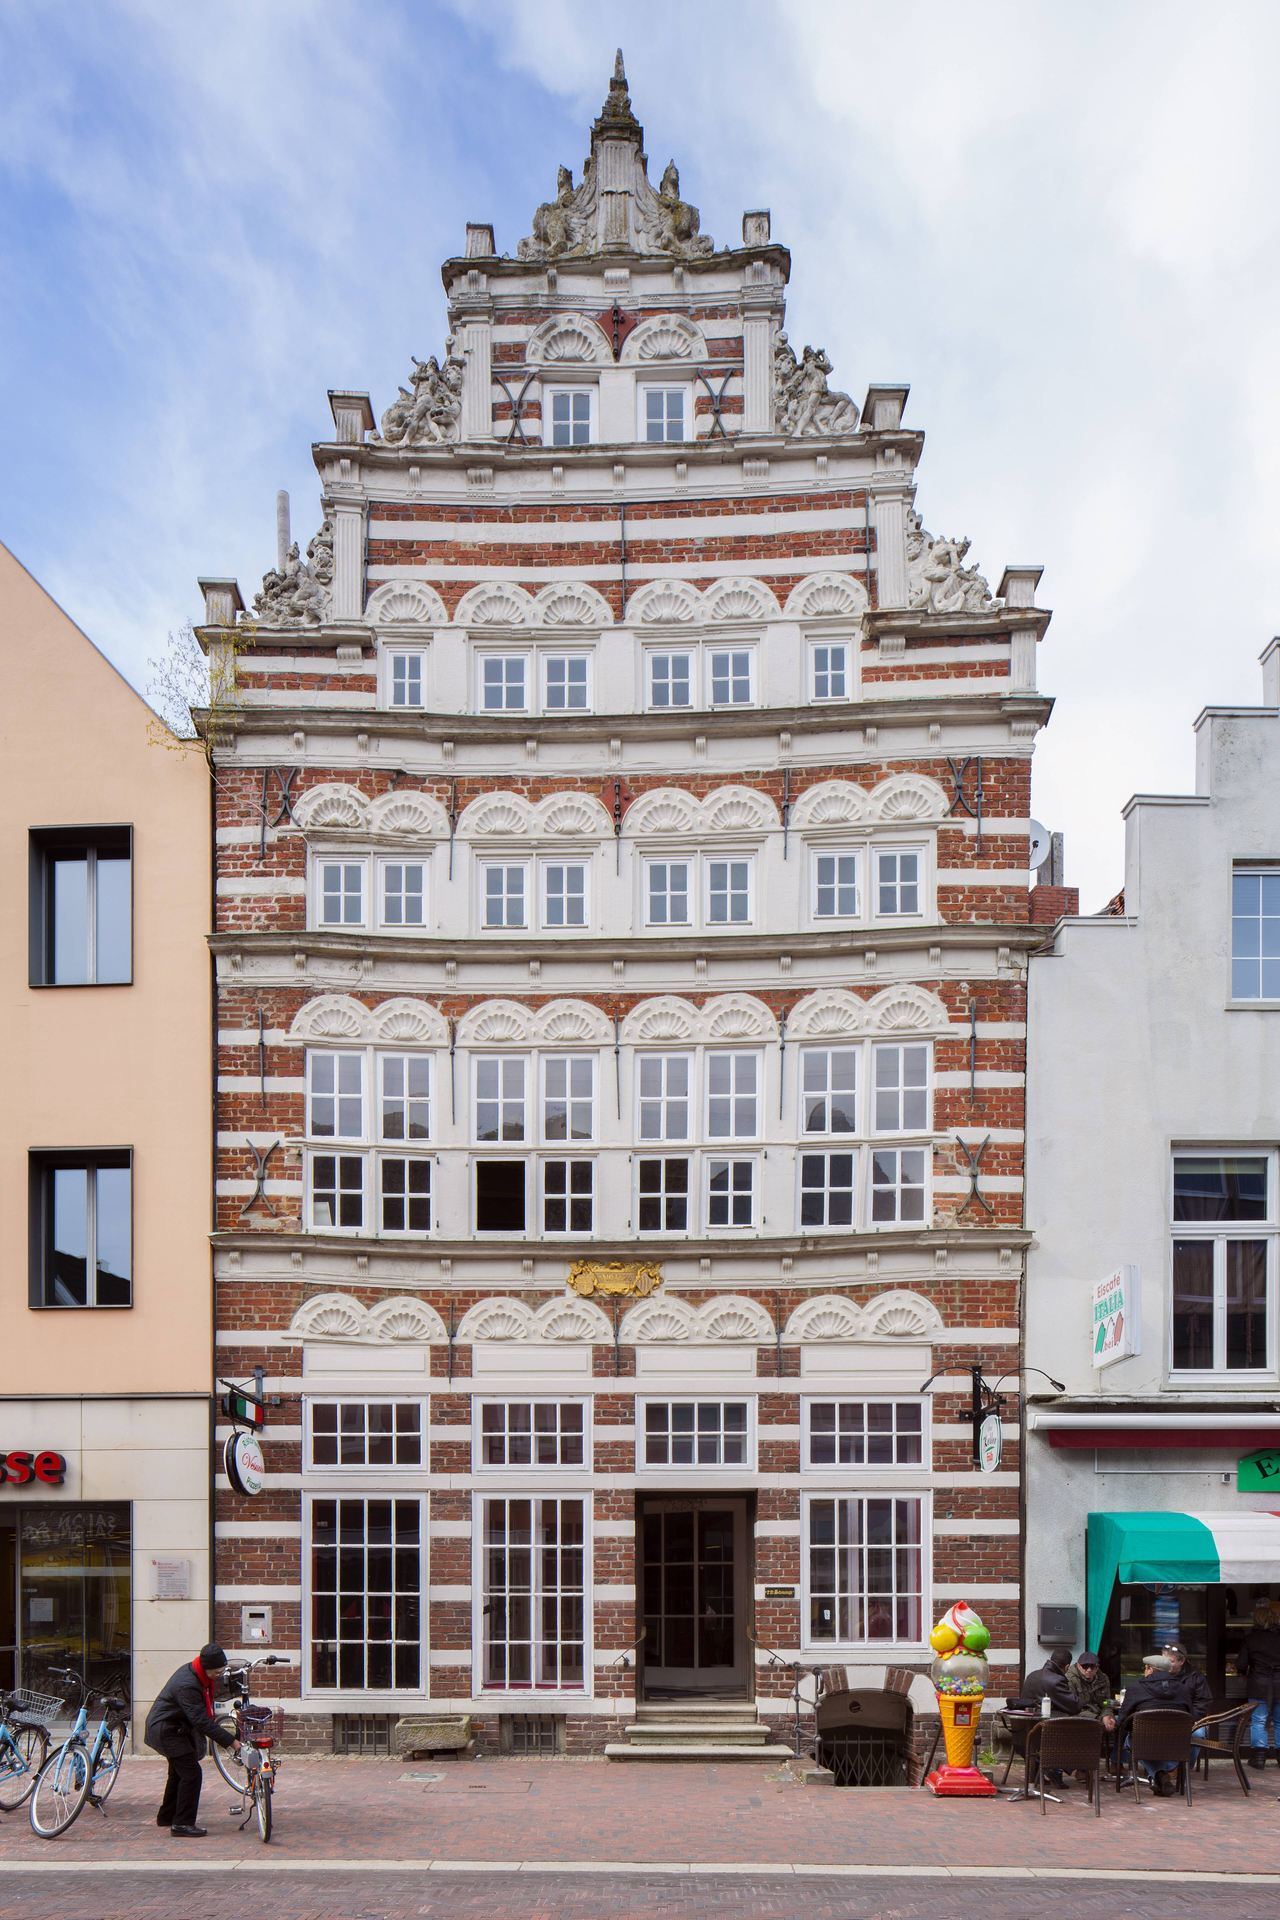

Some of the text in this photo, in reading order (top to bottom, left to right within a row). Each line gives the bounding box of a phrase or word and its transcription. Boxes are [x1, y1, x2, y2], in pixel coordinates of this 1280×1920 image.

[1097, 1271, 1122, 1299] Eiscafé
[1094, 1288, 1124, 1323] ITALIA
[0, 1451, 66, 1484] se
[1251, 1453, 1280, 1480] E
